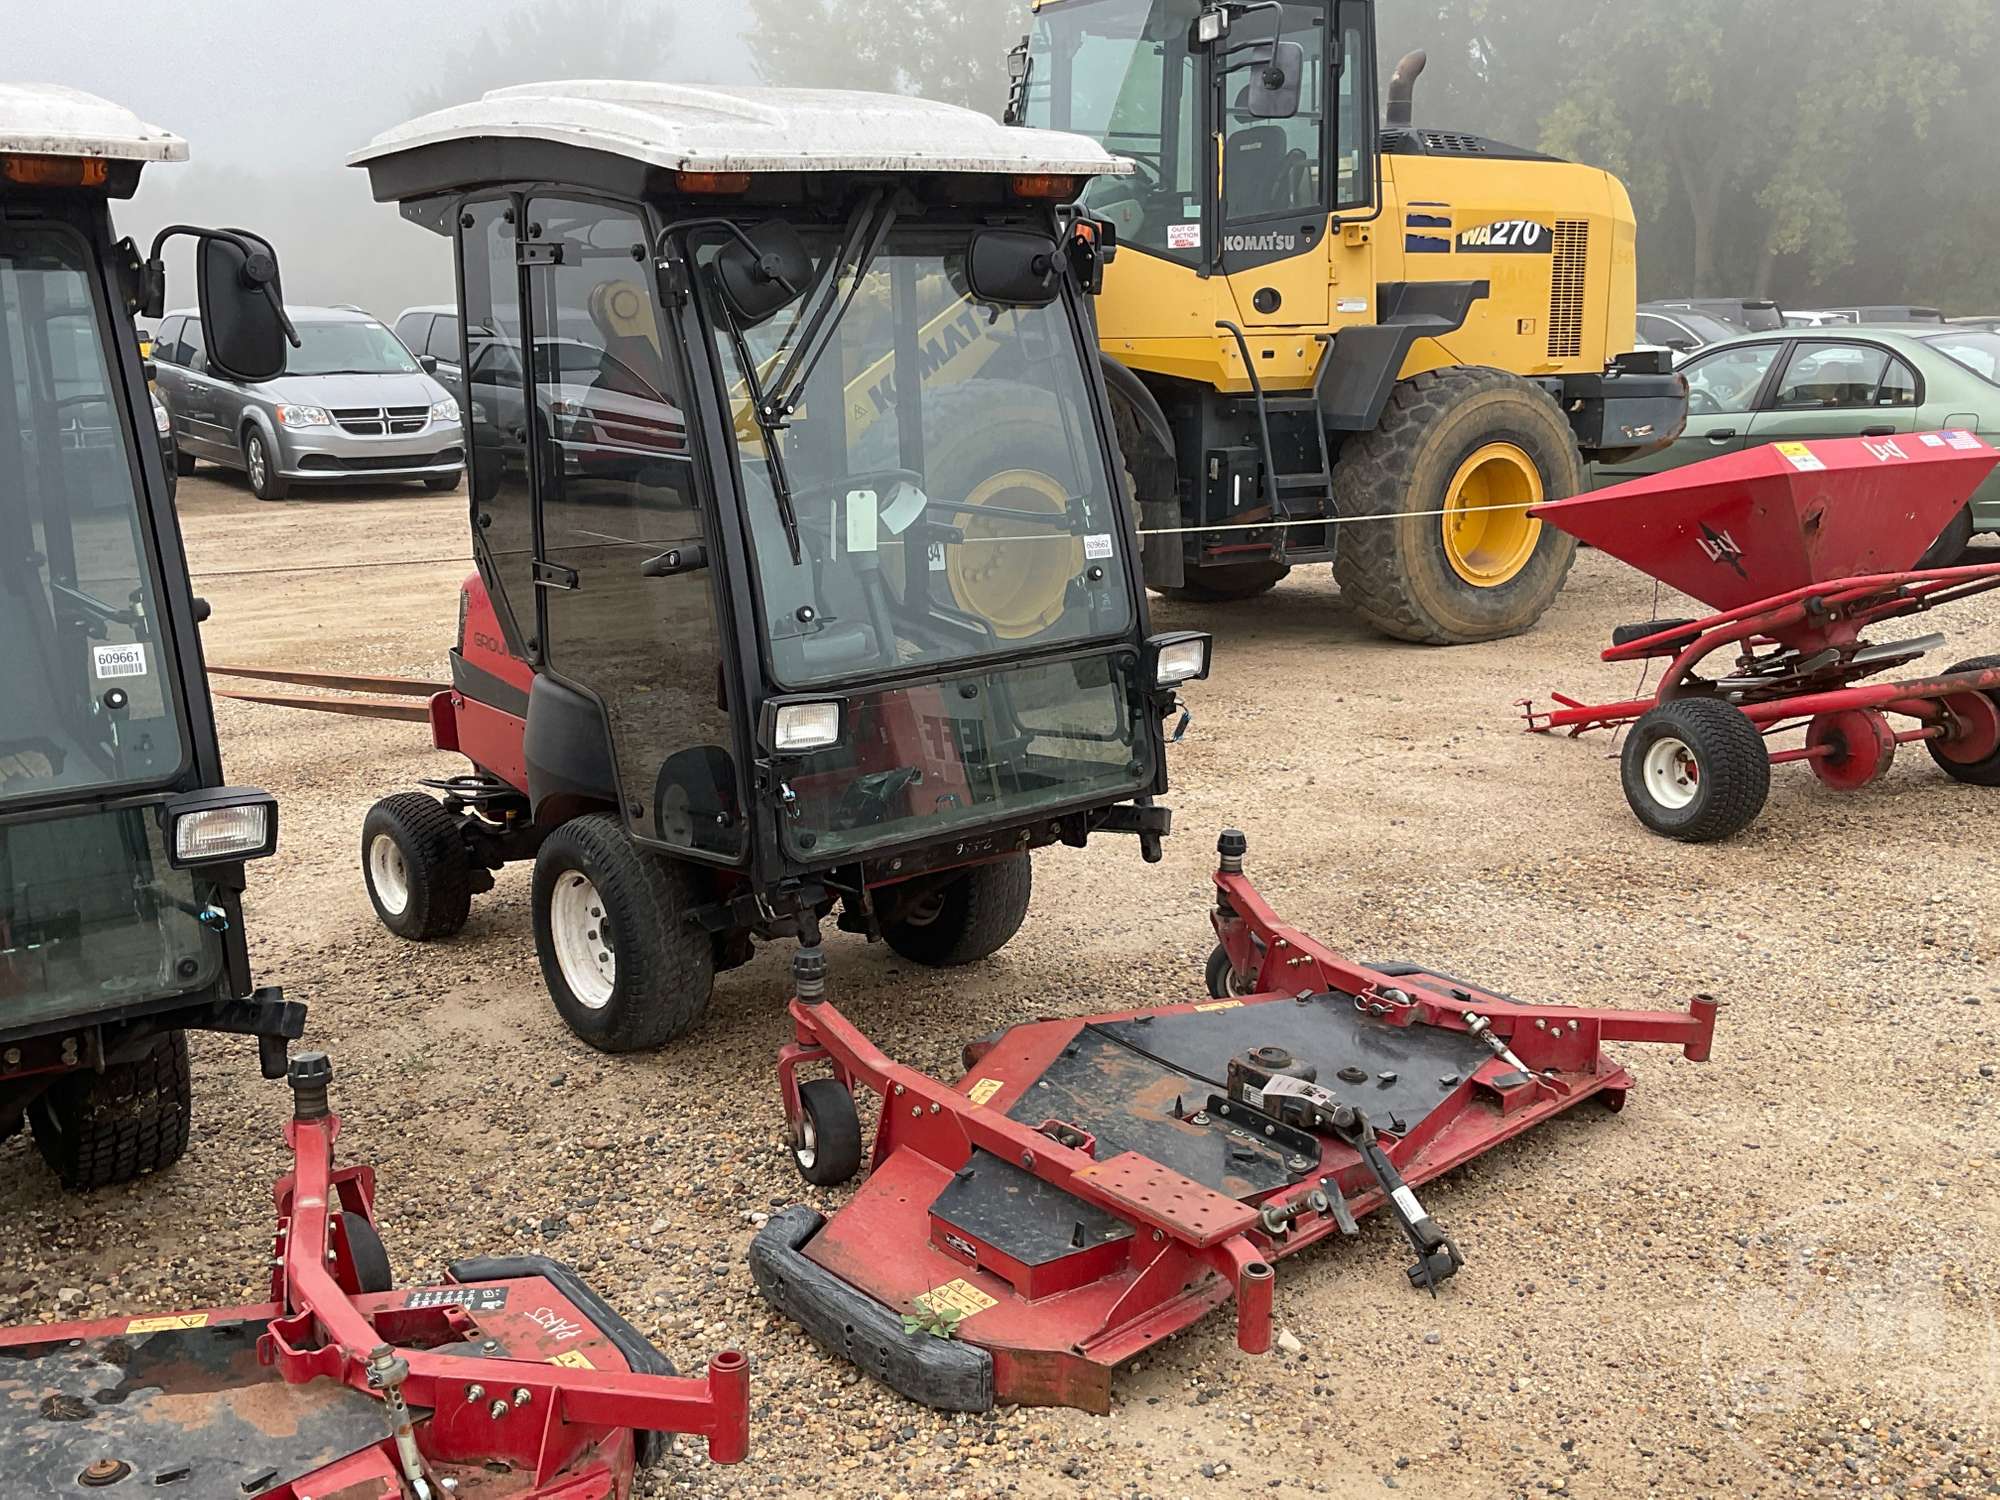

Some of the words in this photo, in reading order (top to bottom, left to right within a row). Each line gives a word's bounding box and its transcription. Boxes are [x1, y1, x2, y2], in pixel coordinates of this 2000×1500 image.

[1223, 231, 1296, 252] KOMATSU
[1461, 220, 1541, 245] WA270
[98, 651, 139, 665] 609661
